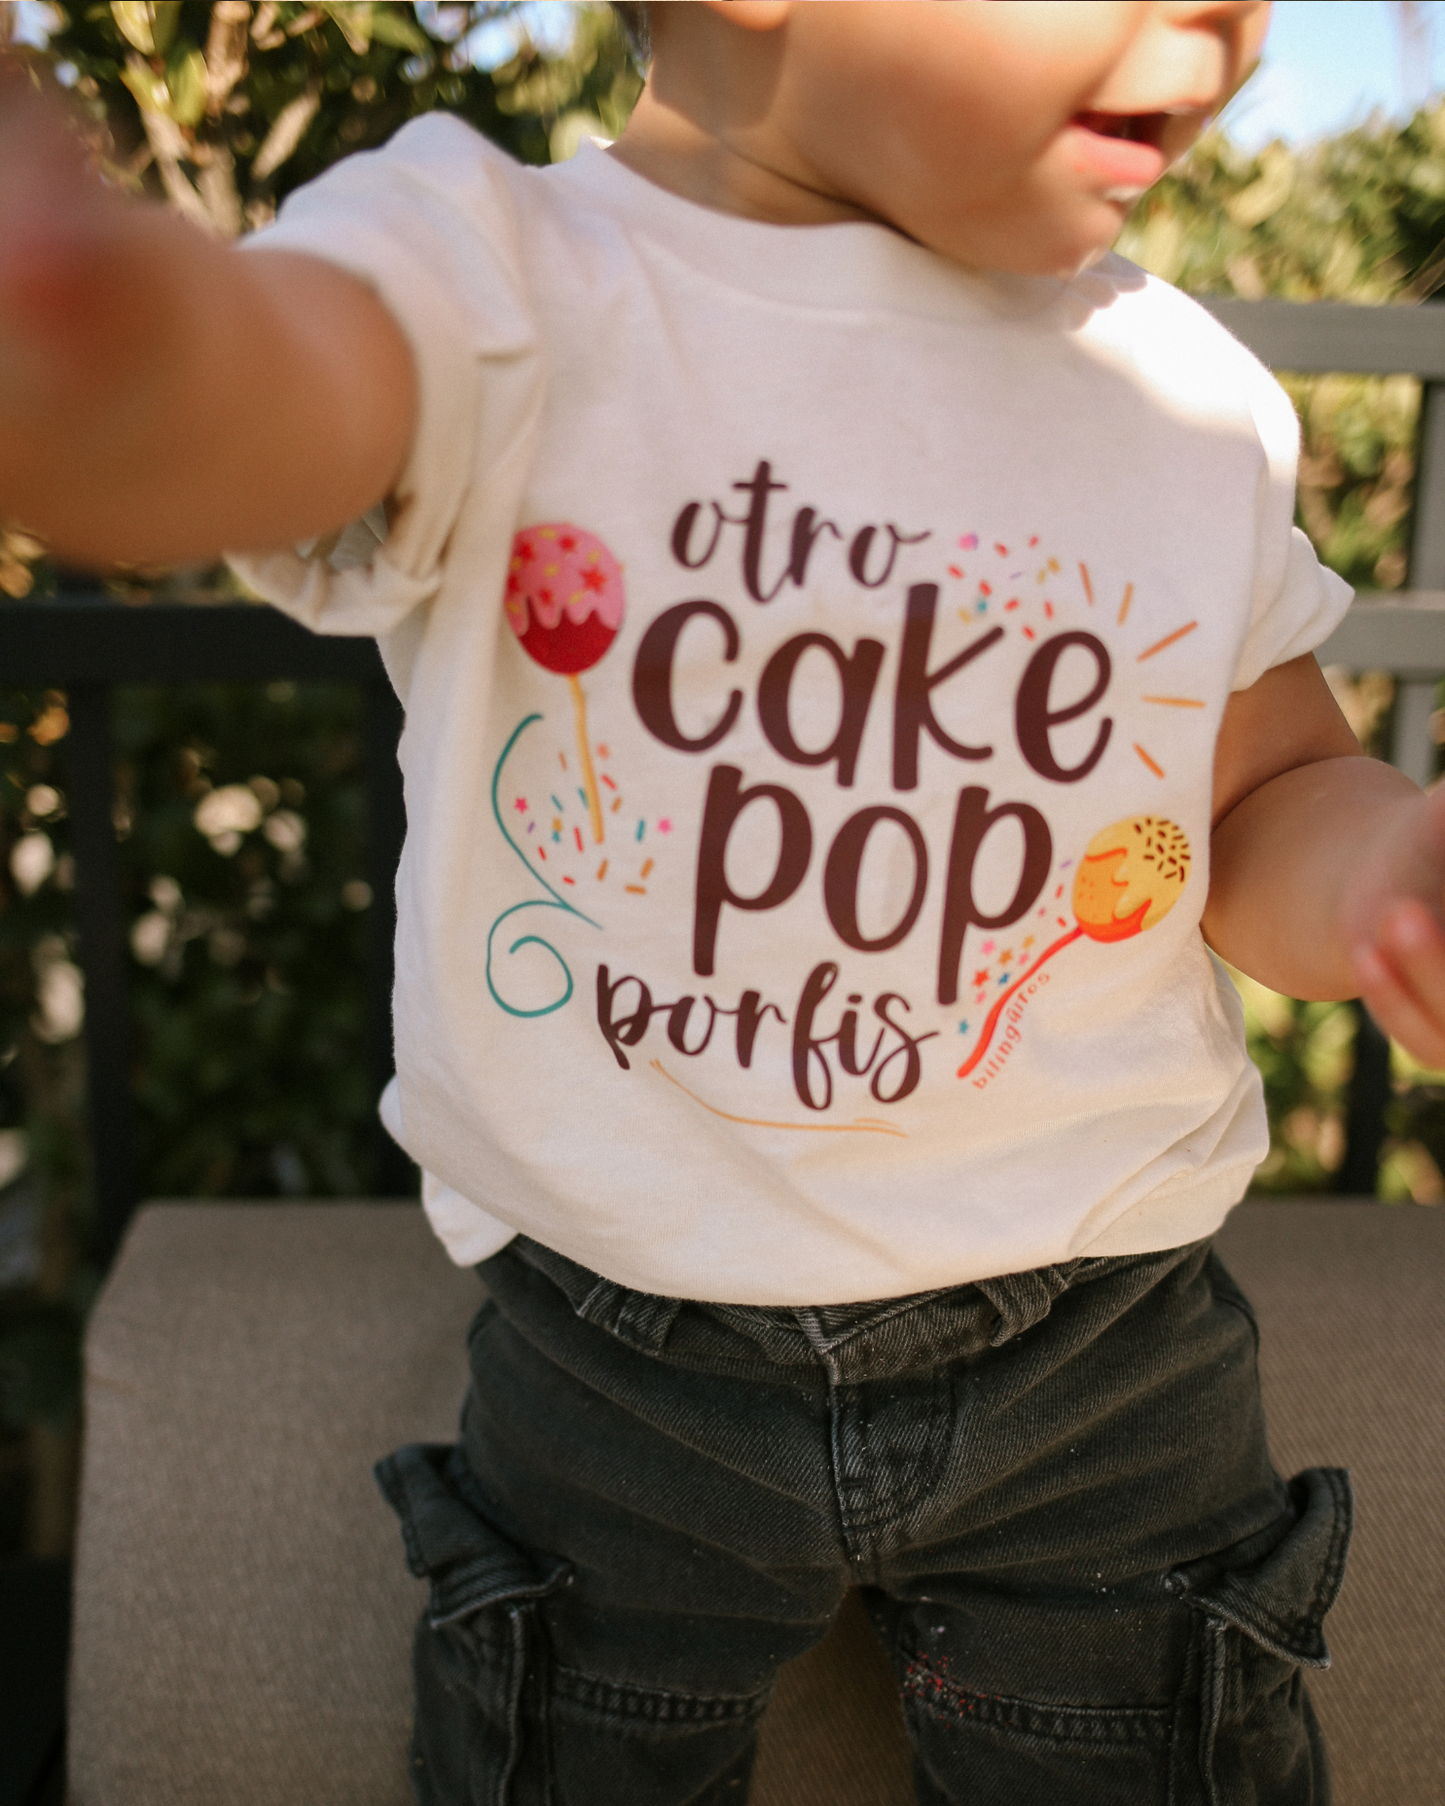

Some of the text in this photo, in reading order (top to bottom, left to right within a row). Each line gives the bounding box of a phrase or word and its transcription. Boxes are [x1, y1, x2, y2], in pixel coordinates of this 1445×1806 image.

[670, 460, 931, 604] otro
[631, 582, 1113, 792] cake
[693, 763, 1053, 1006] pop
[596, 962, 939, 1111] porfis
